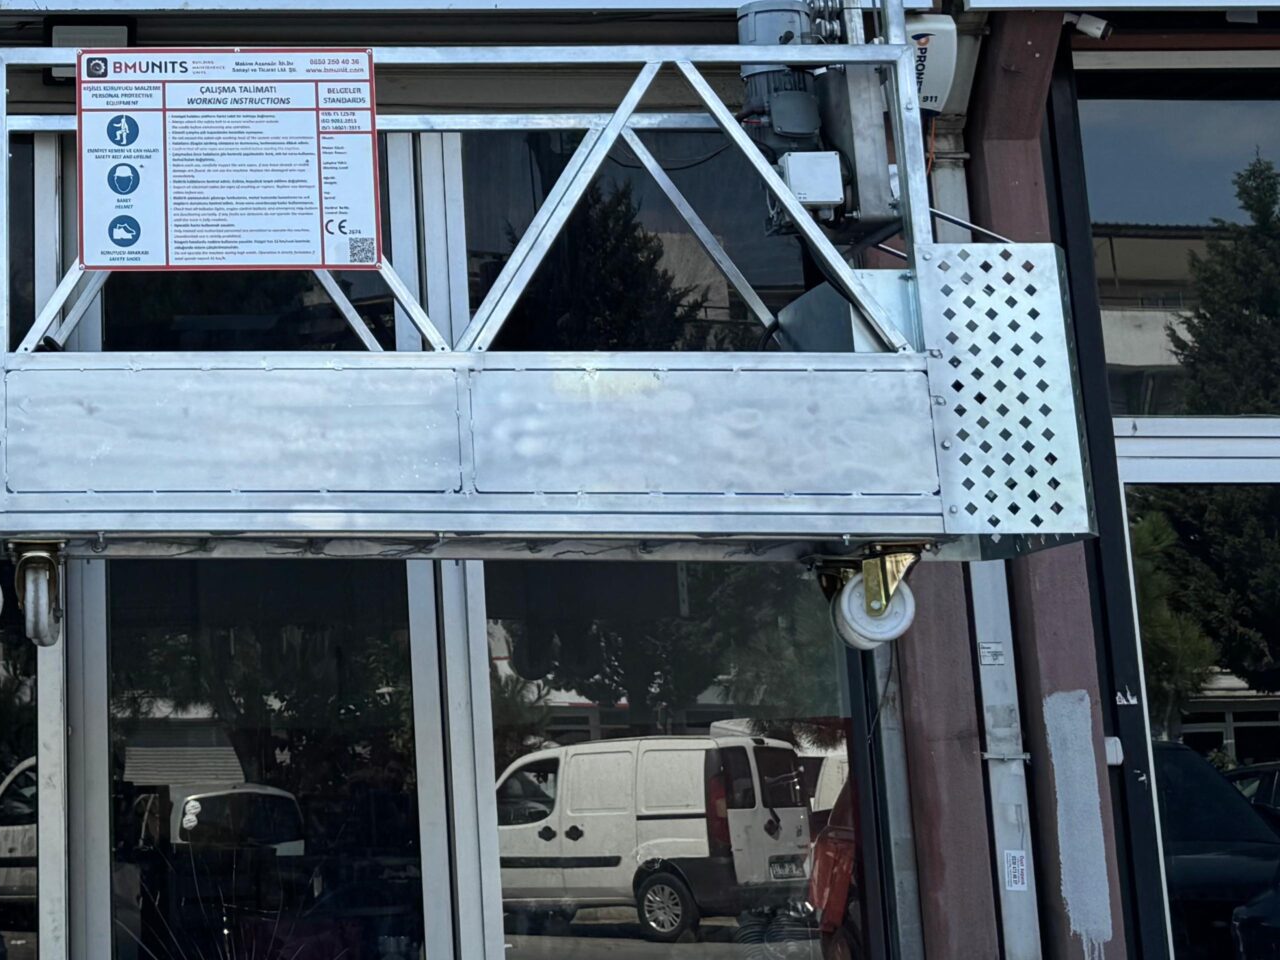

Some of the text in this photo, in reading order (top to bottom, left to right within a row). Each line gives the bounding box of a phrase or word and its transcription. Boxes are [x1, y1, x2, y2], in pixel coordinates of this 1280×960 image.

[113, 61, 188, 74] BMUNITS
[200, 85, 277, 95] ÇALIŞMA TALİMATI
[187, 97, 291, 105] WORKING INSTRUCTIONS
